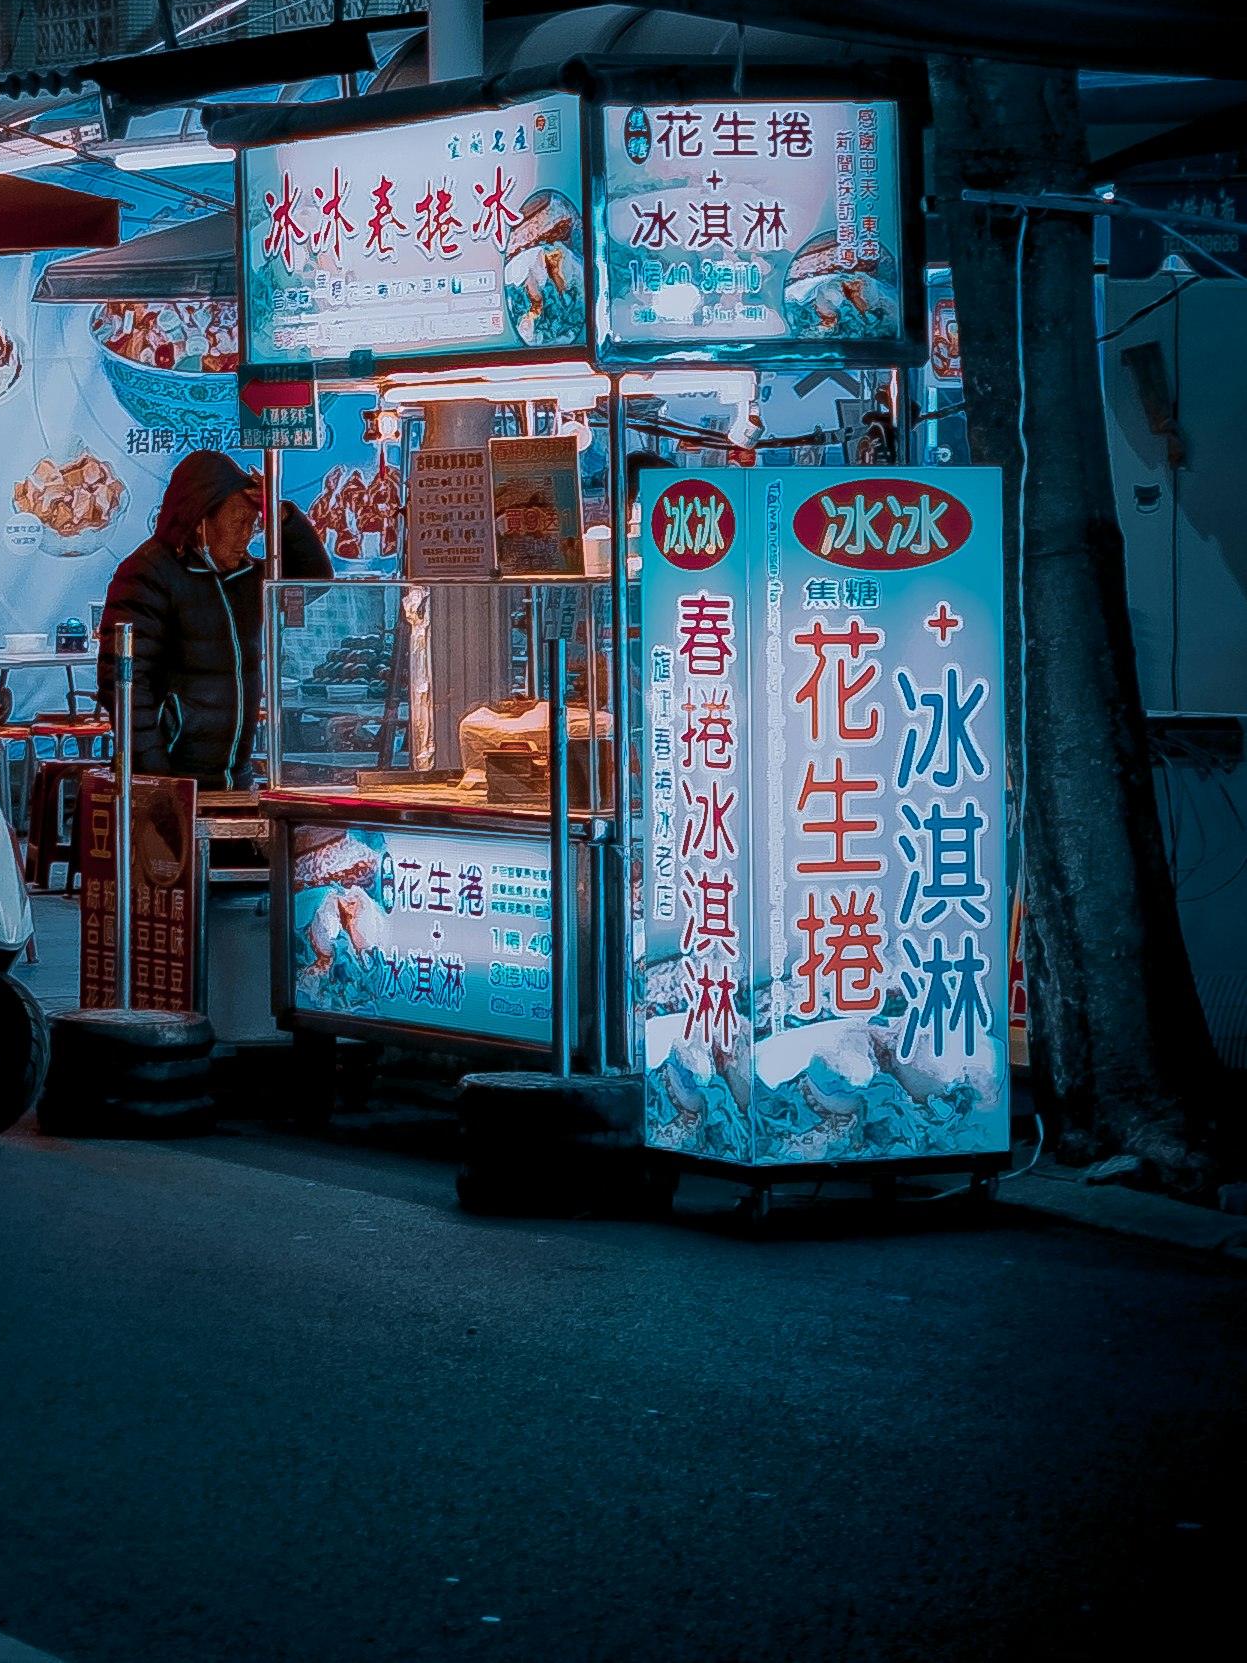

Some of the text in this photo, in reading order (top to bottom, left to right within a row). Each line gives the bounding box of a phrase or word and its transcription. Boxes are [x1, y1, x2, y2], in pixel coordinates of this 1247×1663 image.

[655, 110, 813, 158] 花生捲
[264, 165, 521, 268] 冰冰春捲冰
[630, 200, 787, 248] 冰淇淋
[662, 495, 725, 555] 冰冰
[820, 494, 950, 557] 冰冰
[804, 577, 881, 609] 焦糖
[678, 594, 737, 1045] 春捲冰淇淋
[794, 620, 883, 1014] 花生捲
[397, 859, 485, 916] 花生捲
[898, 667, 989, 1060] 冰淇淋
